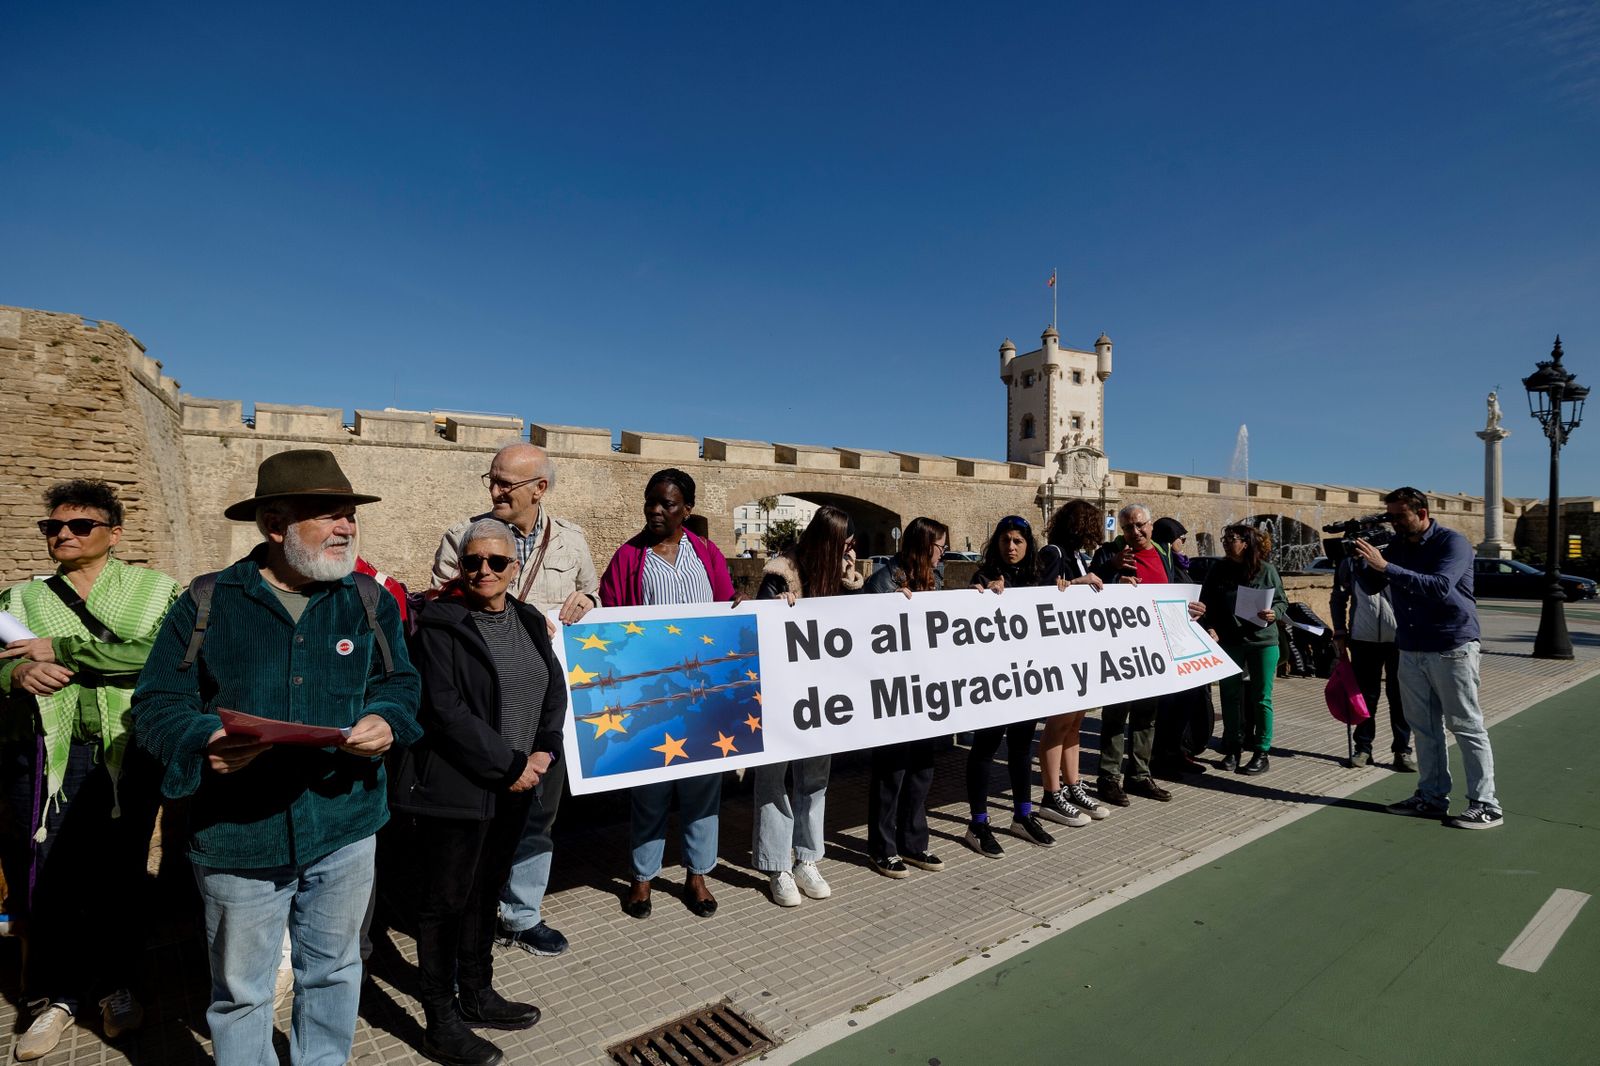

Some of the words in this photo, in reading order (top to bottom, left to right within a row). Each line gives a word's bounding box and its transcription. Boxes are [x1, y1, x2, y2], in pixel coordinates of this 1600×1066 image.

[785, 620, 852, 662] No
[871, 613, 911, 654] al
[926, 608, 1028, 648] Pacto
[1036, 604, 1150, 637] Europeo
[793, 687, 853, 730] de
[870, 660, 1064, 721] Migración
[1071, 662, 1087, 696] y
[1101, 646, 1165, 683] Asilo
[1176, 655, 1224, 676] APDHA
